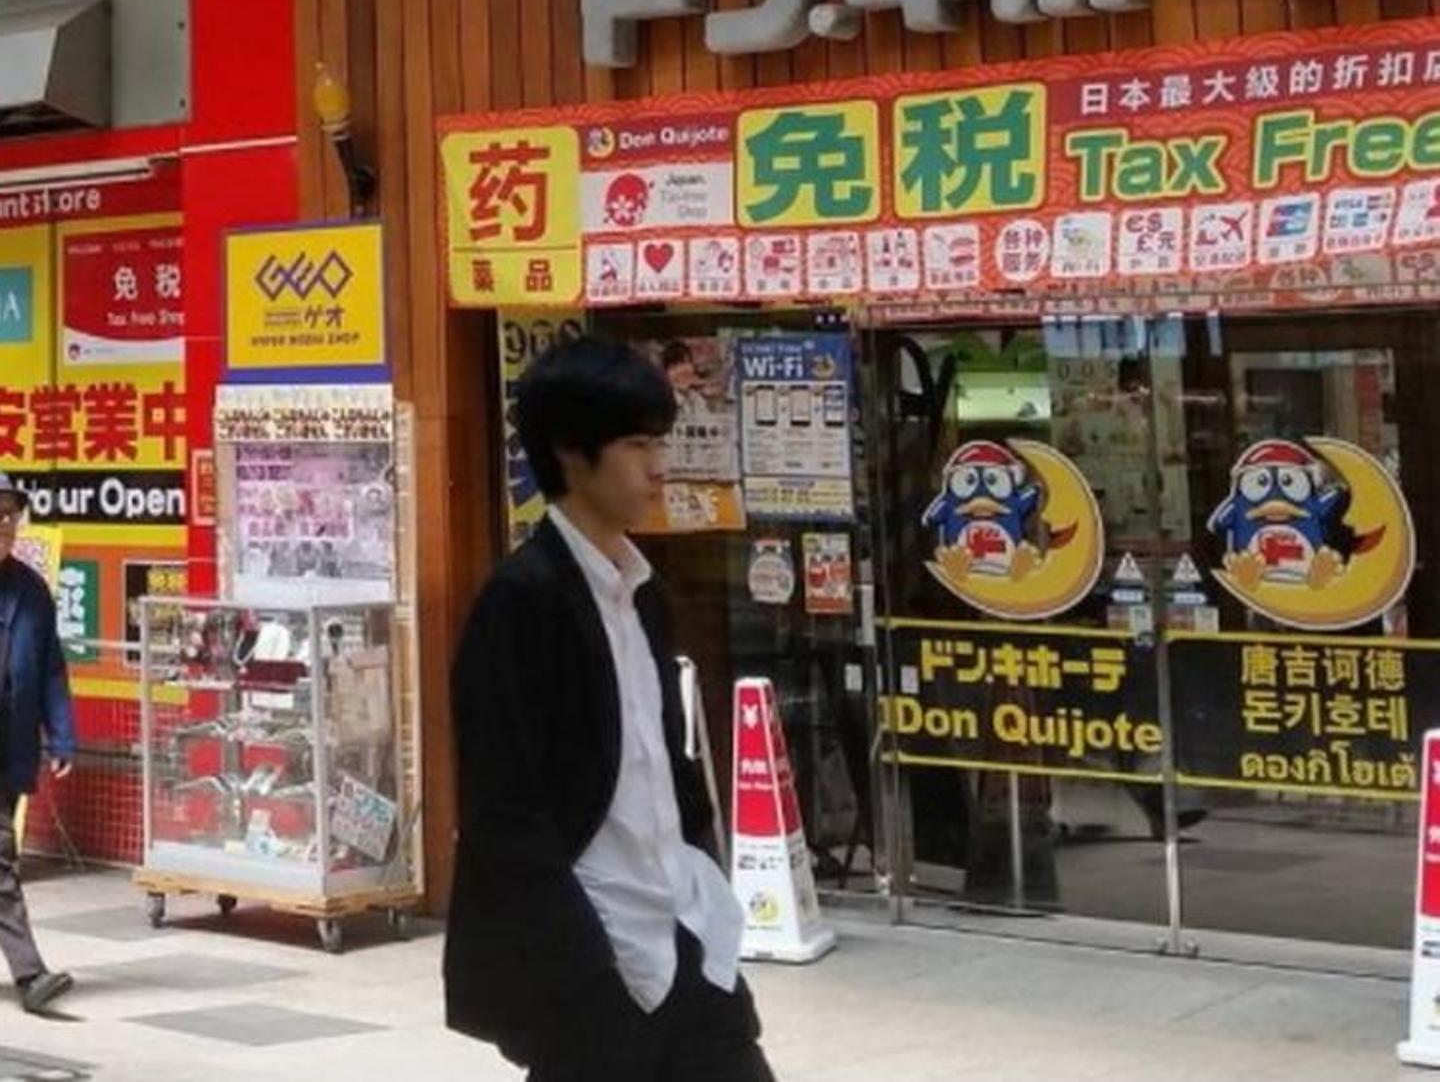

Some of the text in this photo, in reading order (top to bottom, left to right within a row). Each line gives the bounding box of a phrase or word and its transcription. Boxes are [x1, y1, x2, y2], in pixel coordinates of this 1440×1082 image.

[618, 125, 729, 150] Don Quijote
[1068, 111, 1440, 201] Tax Free
[468, 141, 551, 244] 药
[743, 356, 804, 379] Wi-Fi
[99, 477, 186, 518] Open
[1241, 644, 1405, 691] 唐吉诃德
[895, 696, 1162, 757] Don Quijote
[1242, 689, 1408, 742] 돈키호테
